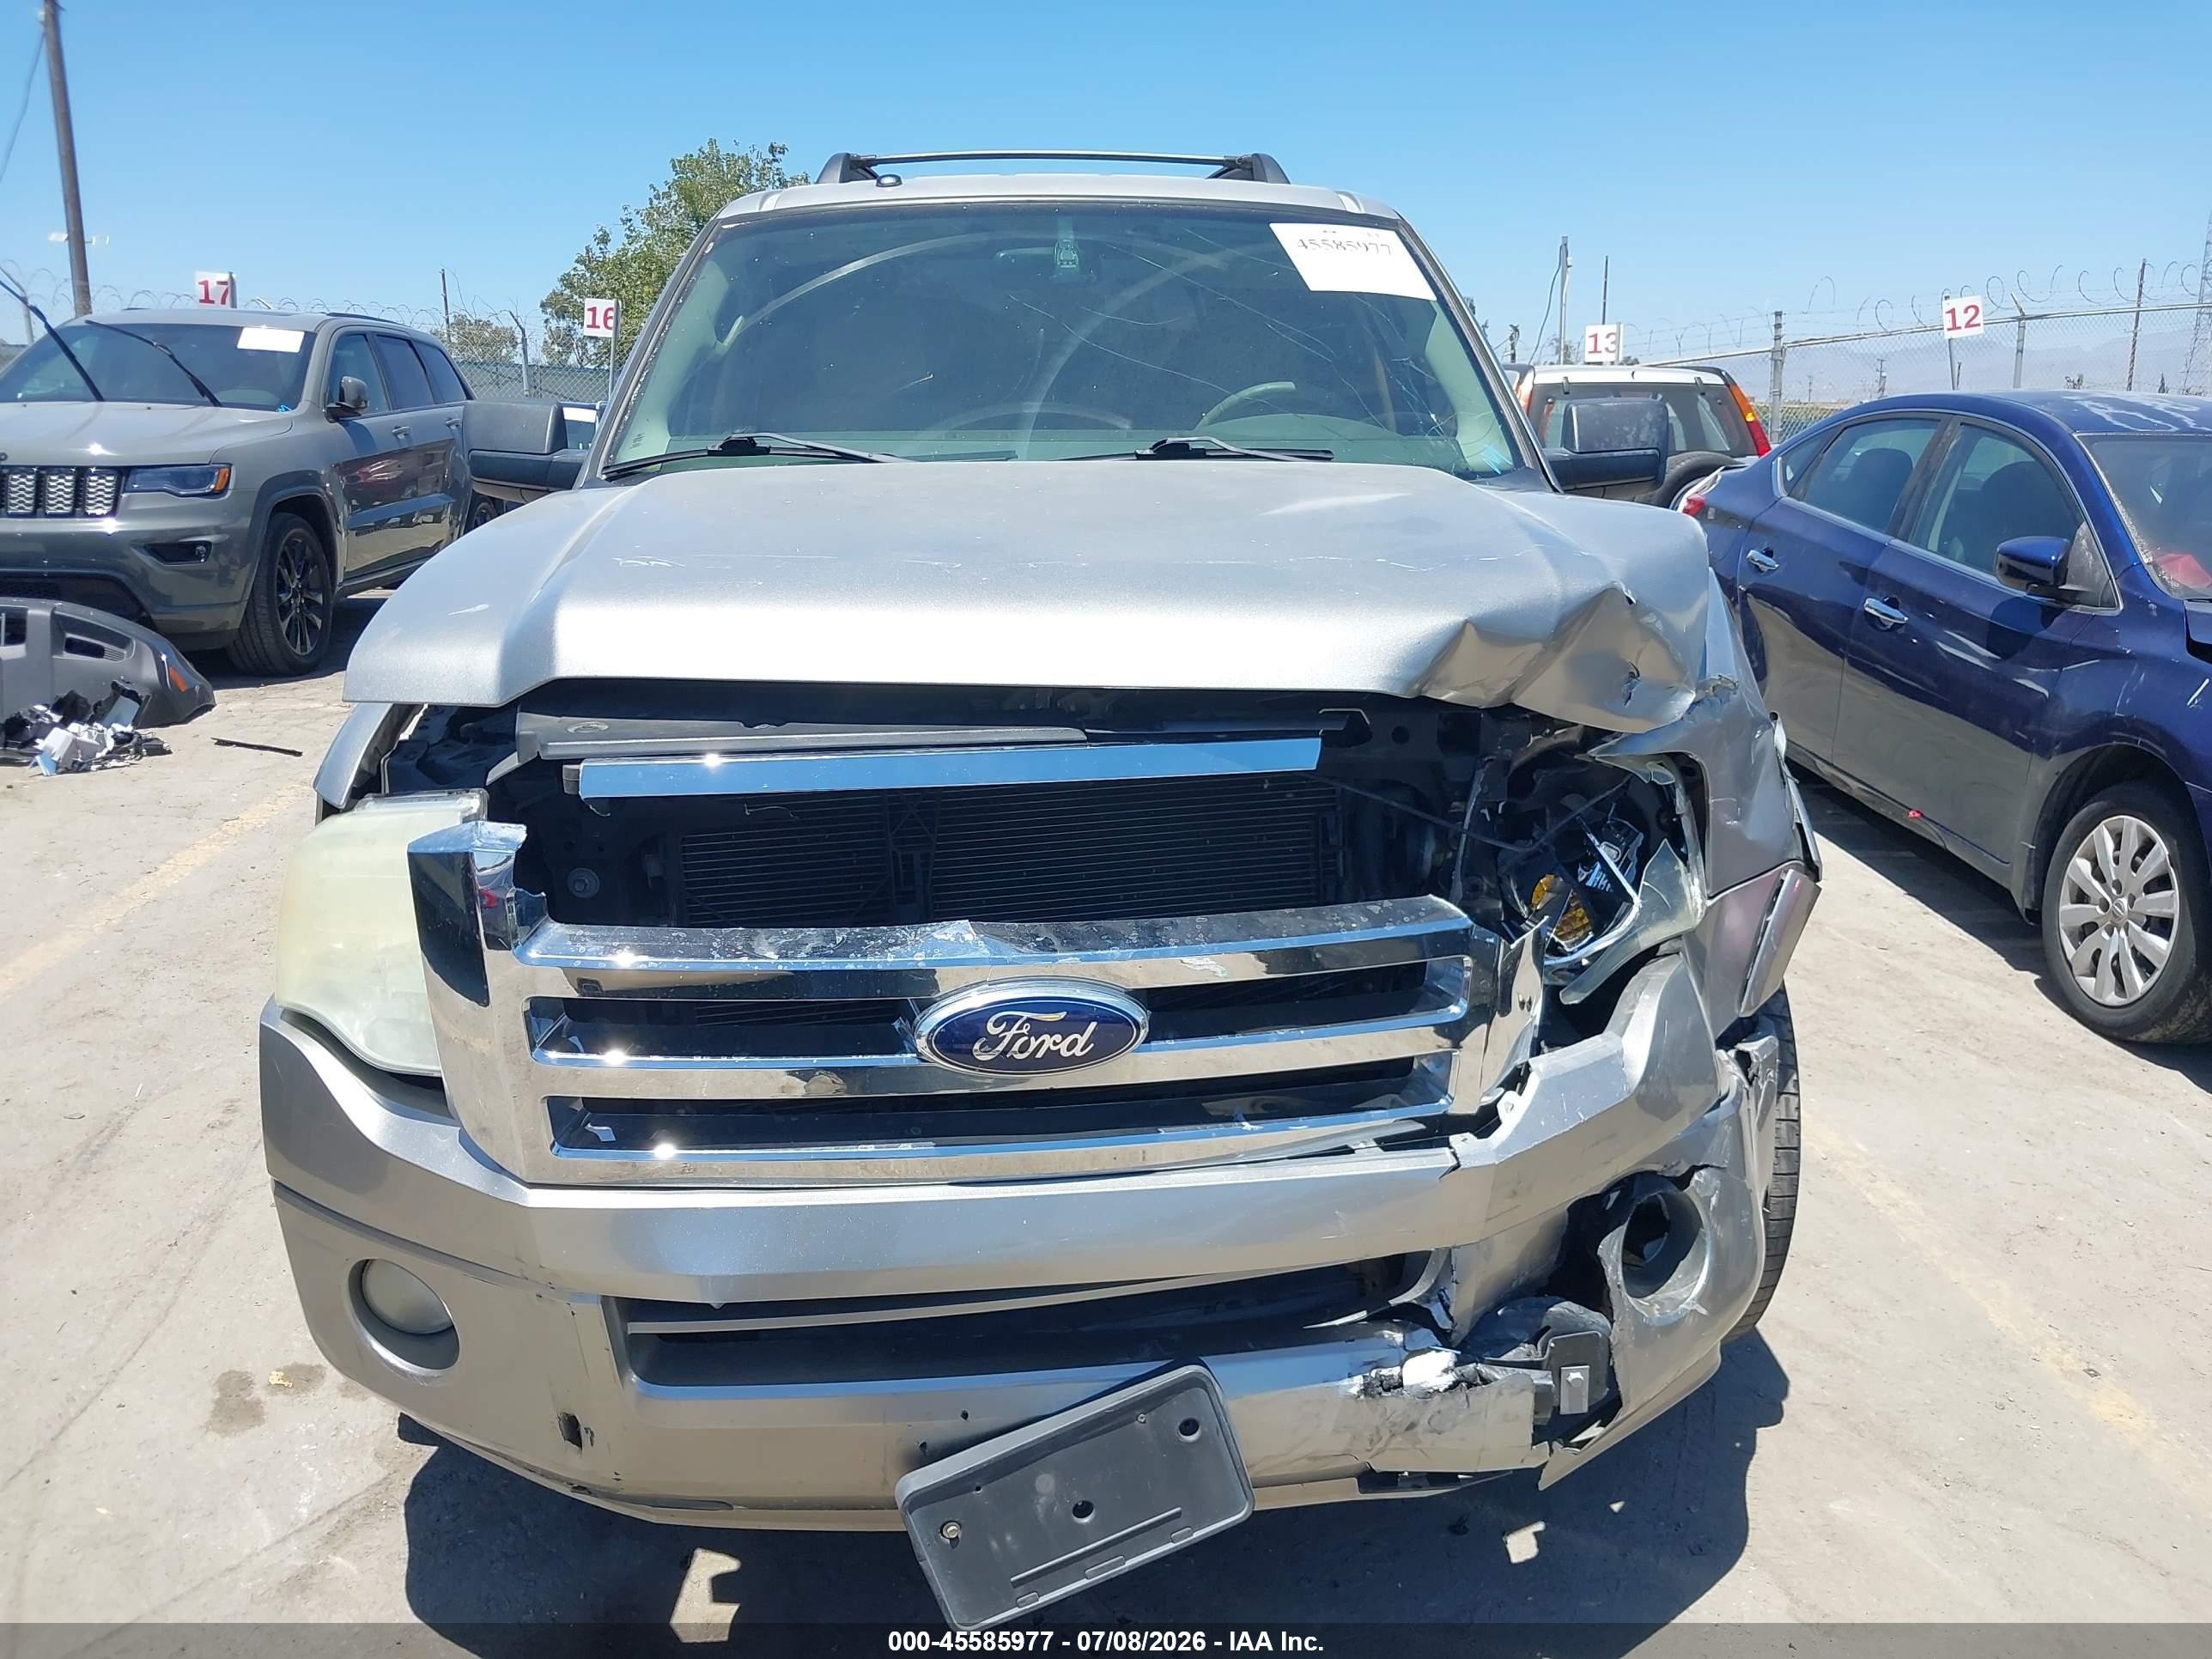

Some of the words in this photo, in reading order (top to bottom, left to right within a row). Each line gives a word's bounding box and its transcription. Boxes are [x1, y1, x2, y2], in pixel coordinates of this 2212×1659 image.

[198, 279, 229, 306] 17
[1944, 304, 1981, 331] 12
[1588, 331, 1617, 355] 13
[972, 1011, 1097, 1061] Ford
